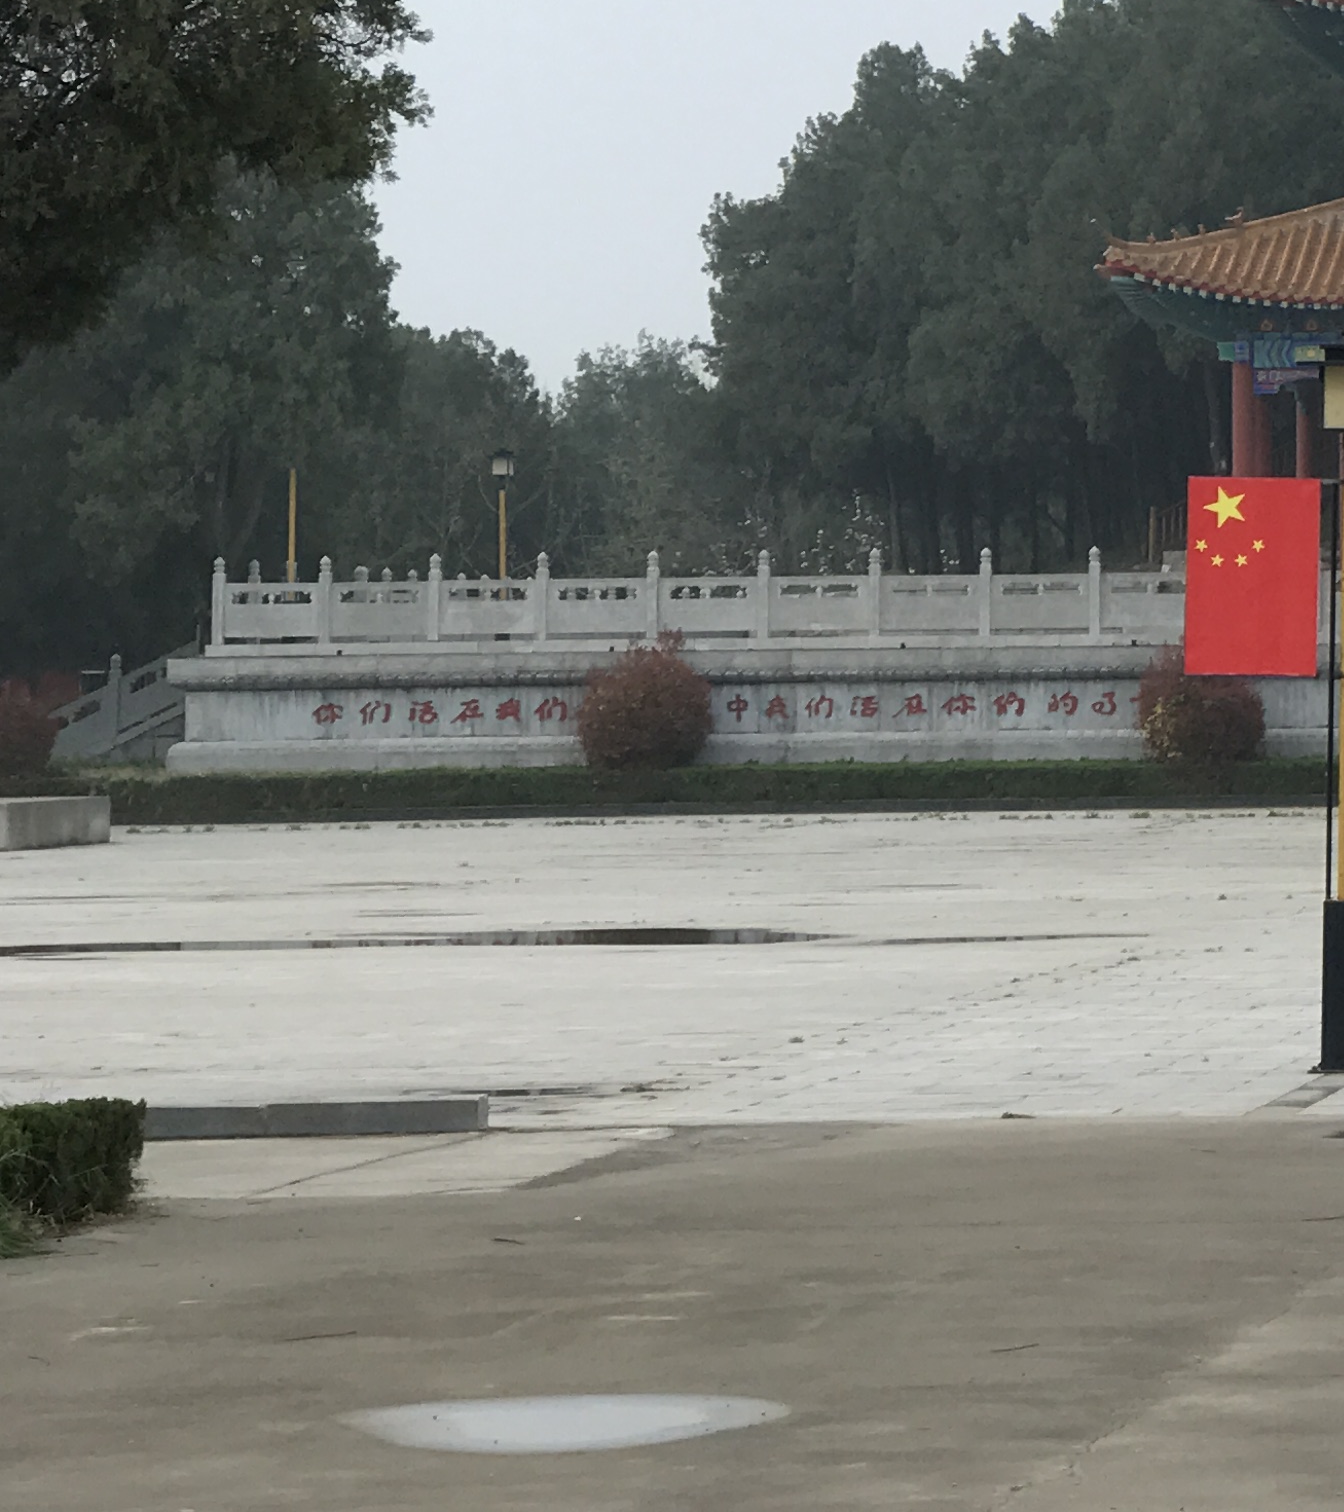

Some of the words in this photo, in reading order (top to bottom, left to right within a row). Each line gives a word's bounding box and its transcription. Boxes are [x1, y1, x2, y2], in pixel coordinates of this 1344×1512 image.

[312, 696, 568, 726] 你们活在我们
